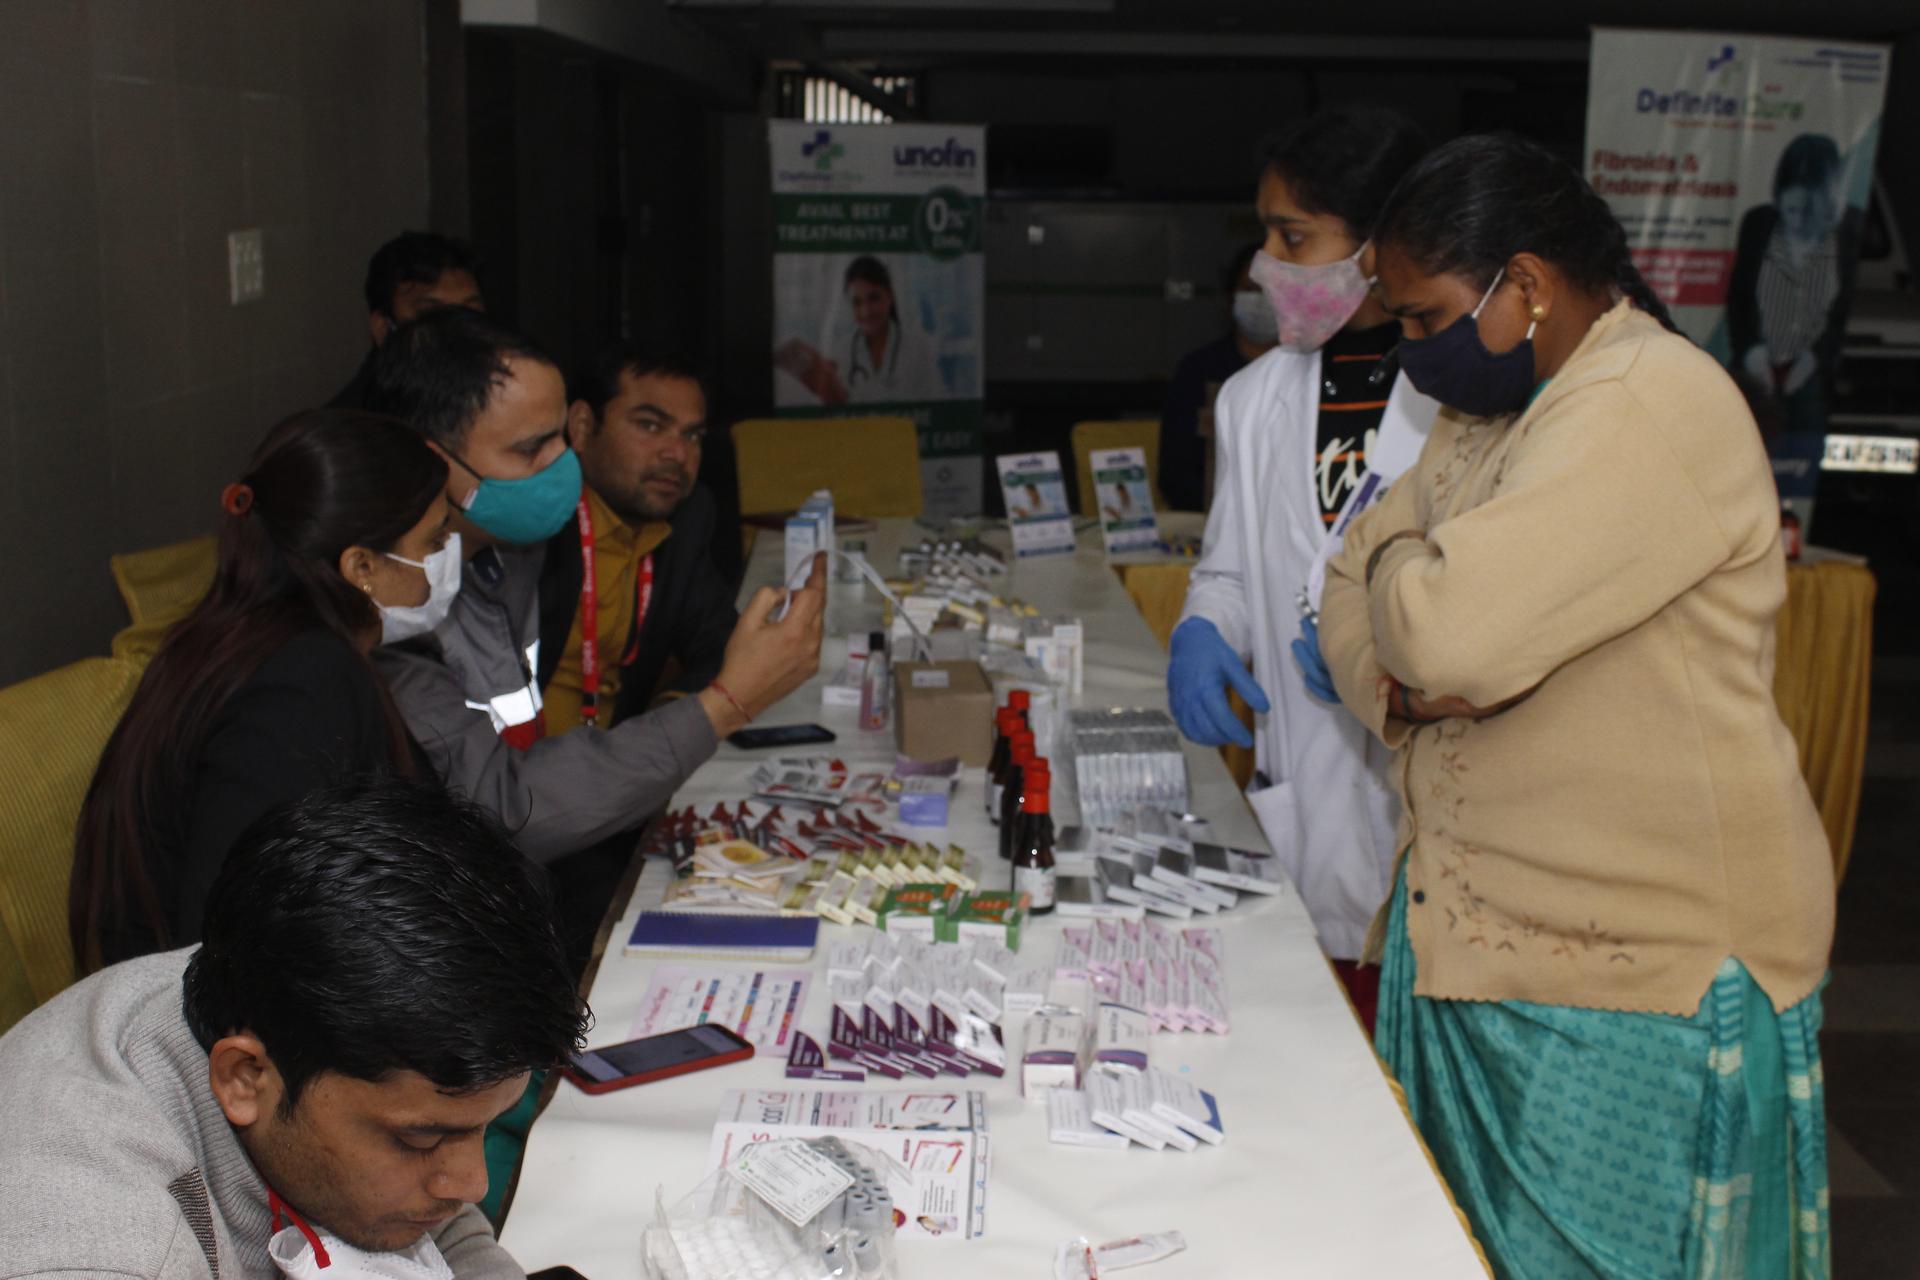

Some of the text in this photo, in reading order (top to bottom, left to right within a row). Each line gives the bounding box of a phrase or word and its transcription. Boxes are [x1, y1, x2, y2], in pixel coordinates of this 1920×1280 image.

[1636, 88, 1738, 116] Definite
[893, 137, 976, 168] unofin
[850, 203, 892, 219] BEST
[775, 224, 884, 241] TREATMENTS
